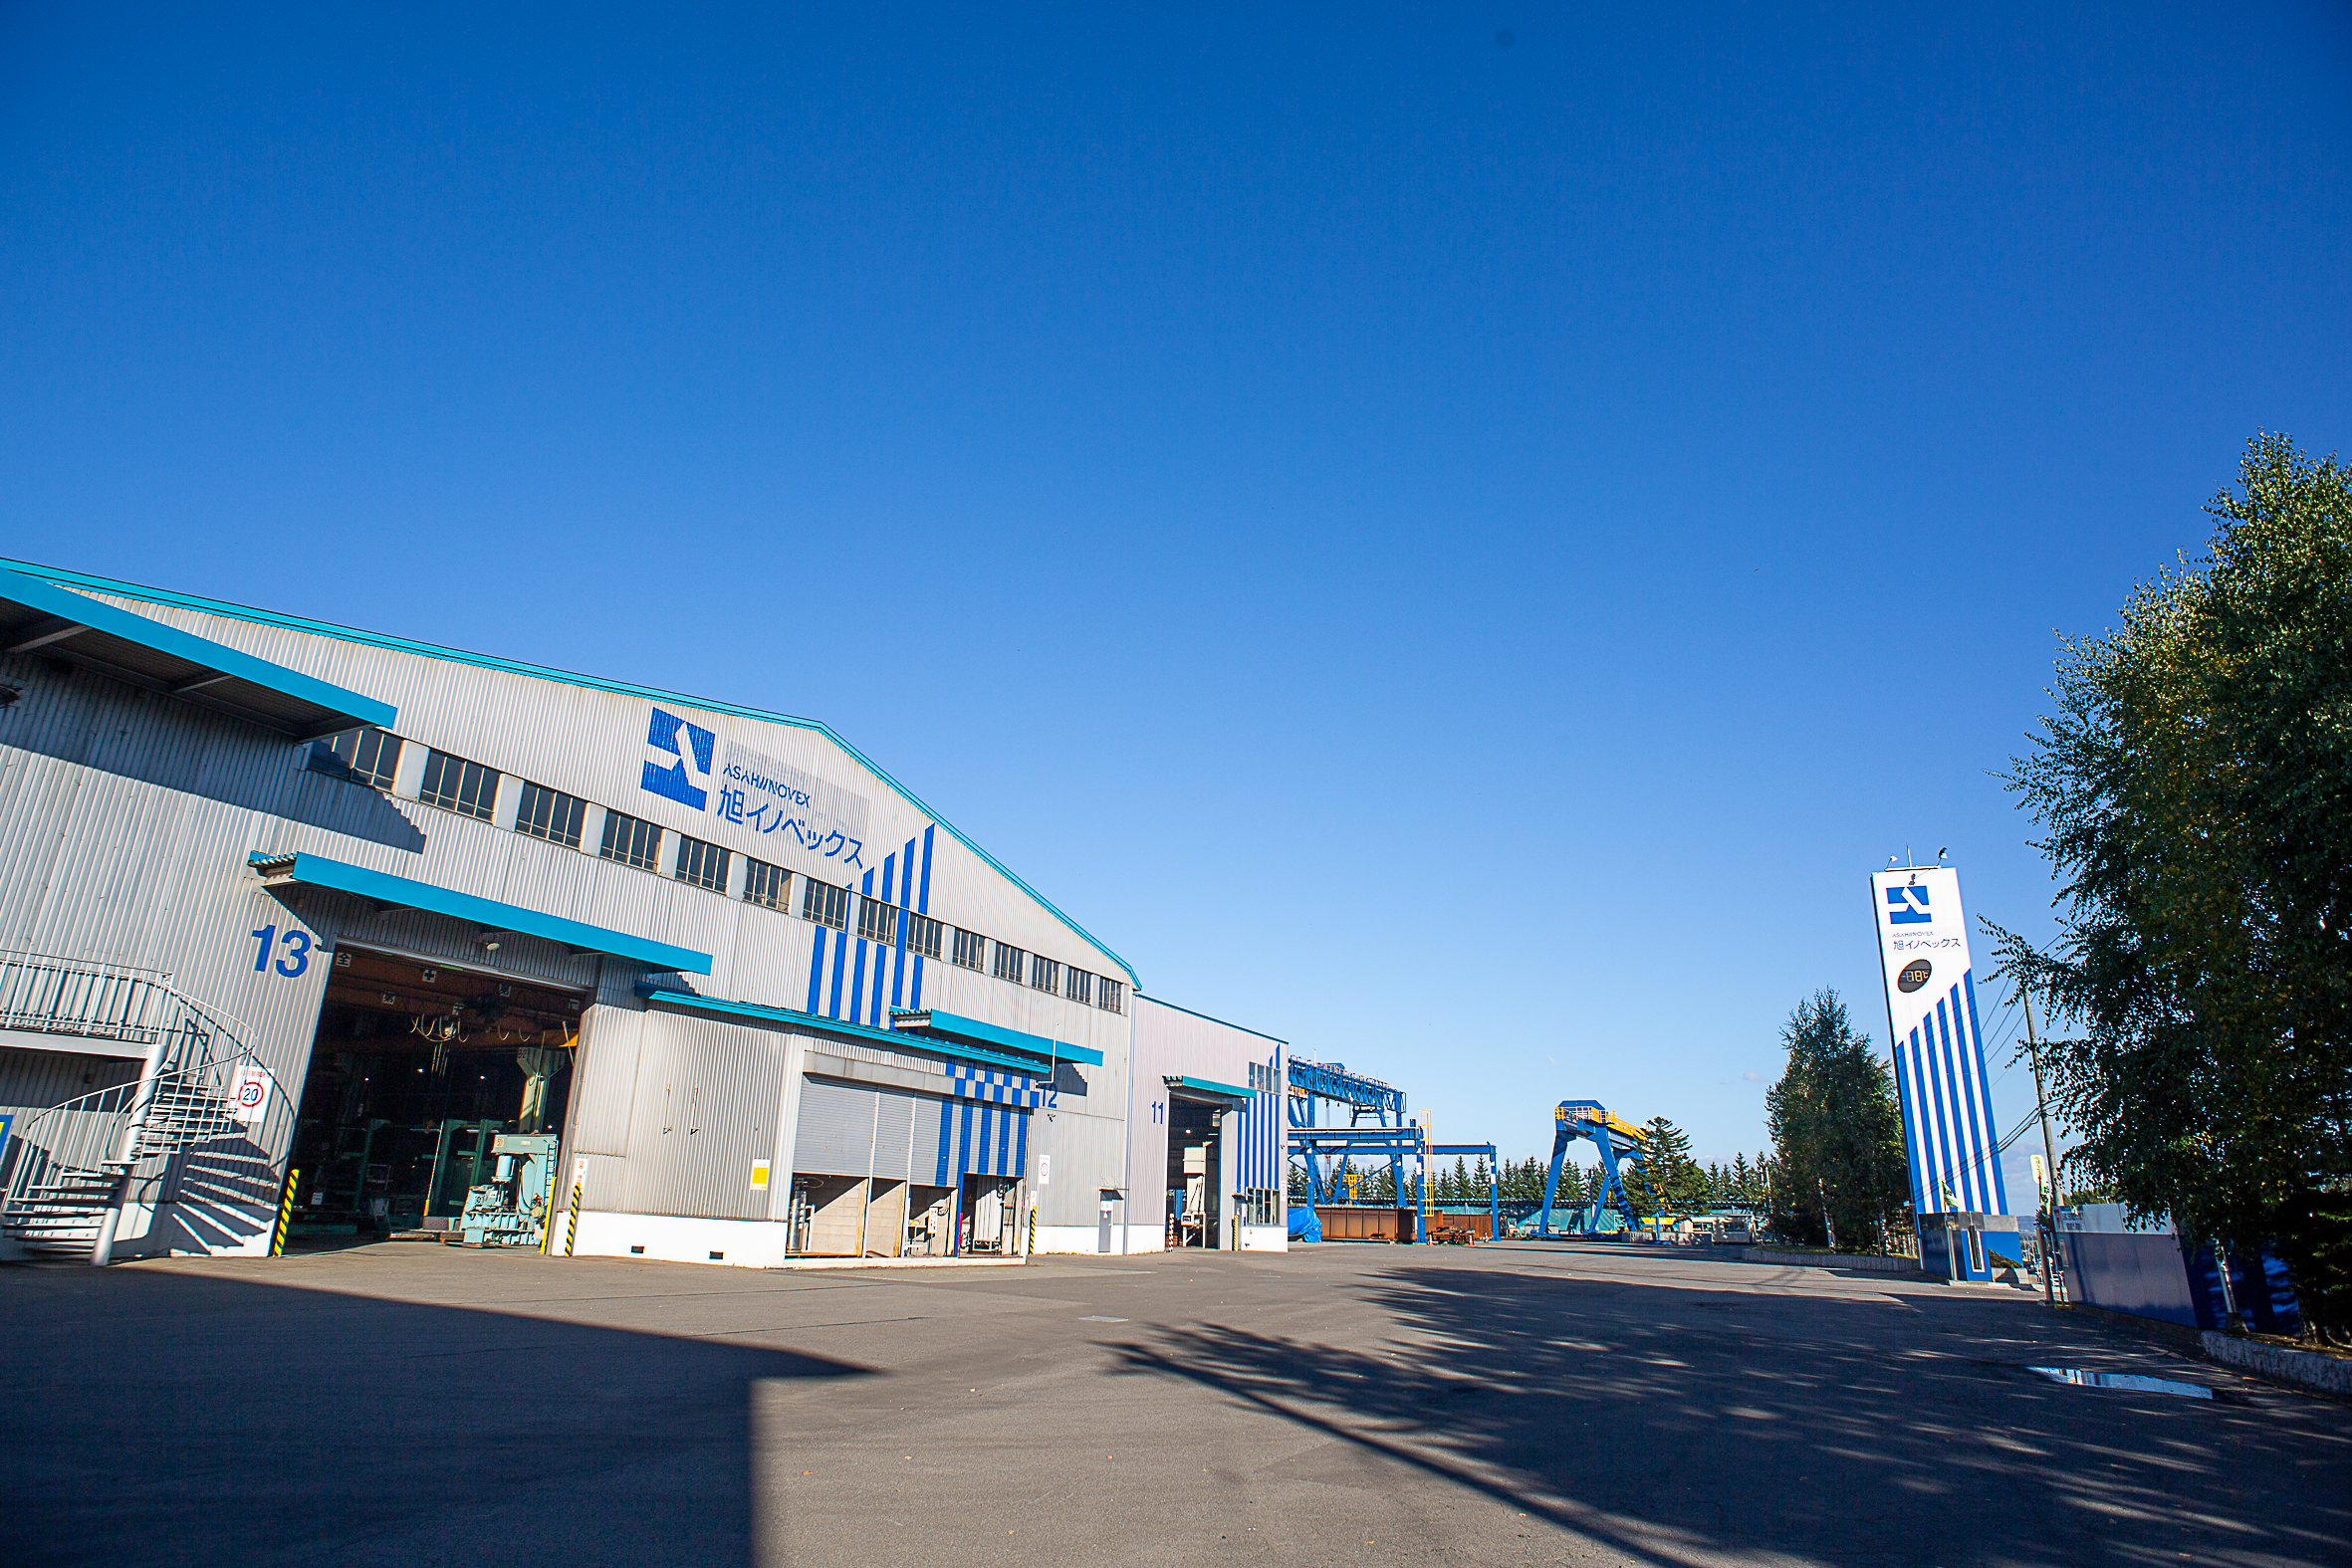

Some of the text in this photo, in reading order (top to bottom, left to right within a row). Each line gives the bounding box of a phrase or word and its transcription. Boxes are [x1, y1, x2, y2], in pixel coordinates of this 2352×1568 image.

[717, 784, 863, 870] 旭イノベックス
[251, 924, 310, 979] 13
[1893, 938, 1961, 950] 旭イノベックス
[242, 1087, 258, 1101] 20
[1041, 1082, 1058, 1108] 12
[1152, 1101, 1164, 1124] 11
